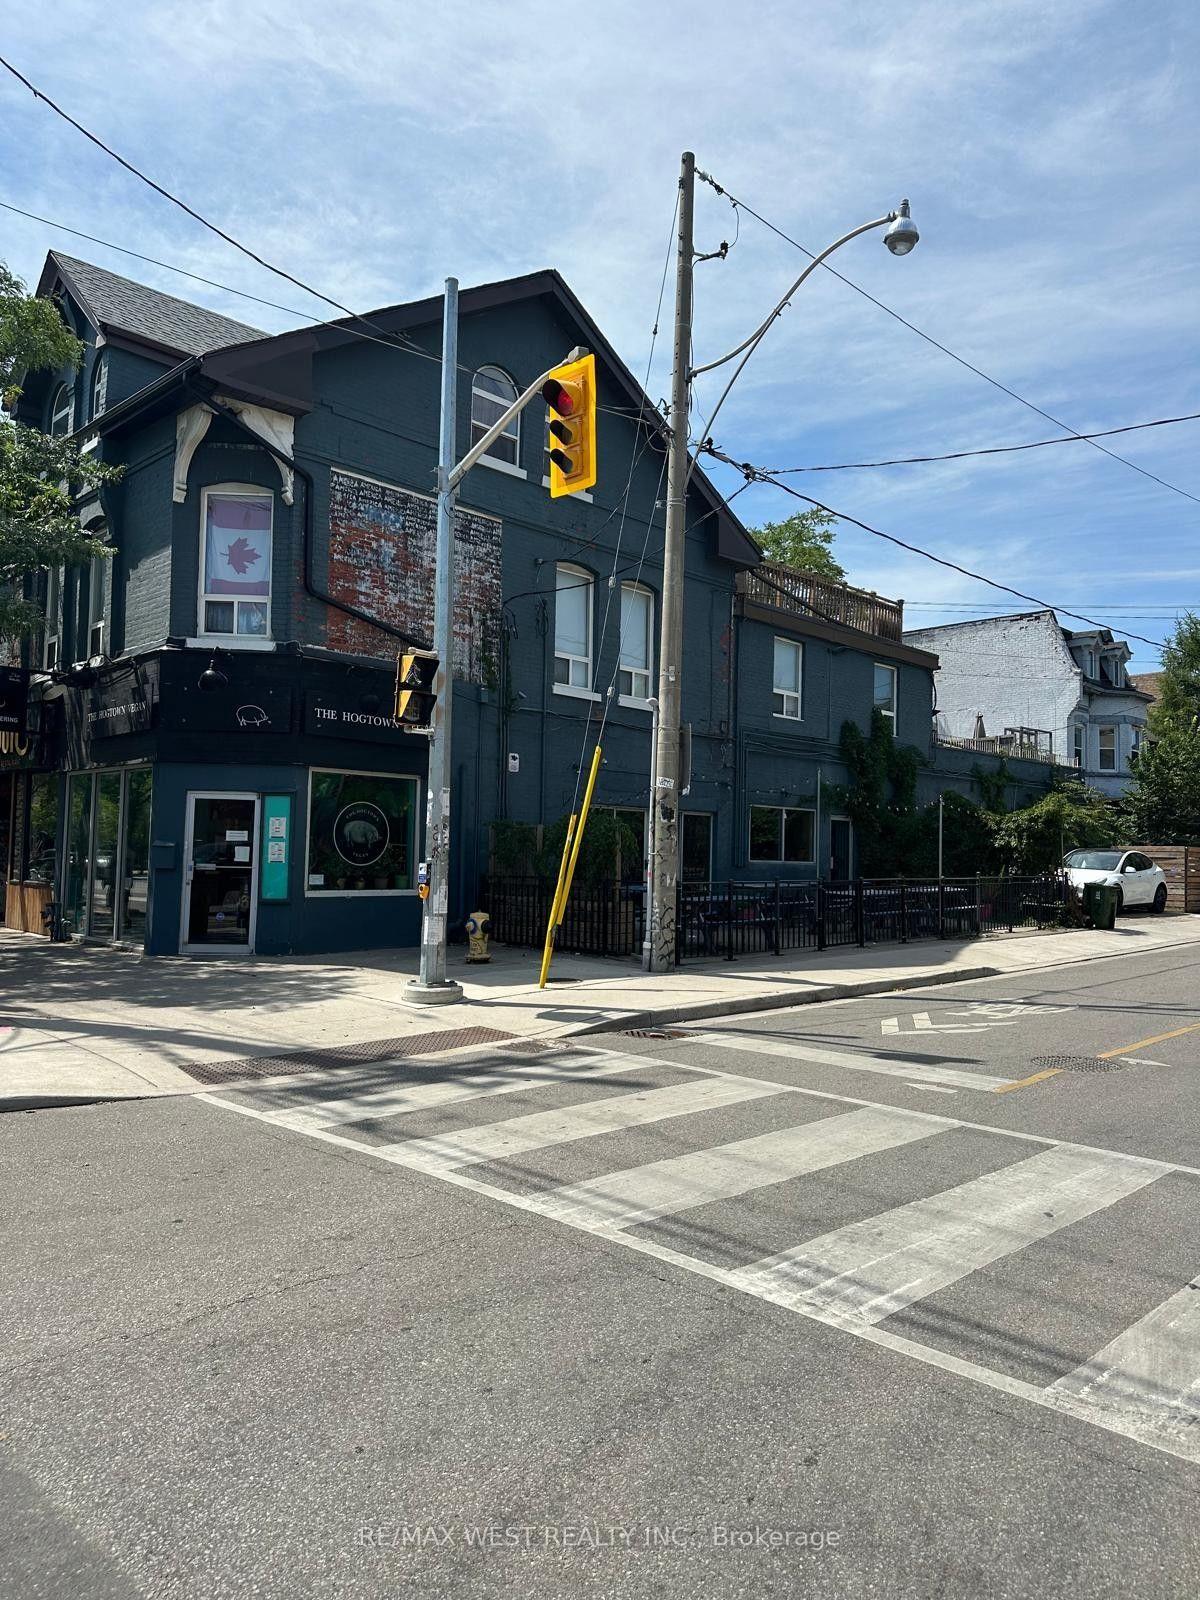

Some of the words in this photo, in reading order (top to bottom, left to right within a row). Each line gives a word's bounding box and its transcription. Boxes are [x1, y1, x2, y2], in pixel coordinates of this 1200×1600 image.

[98, 705, 126, 720] HOGTOWN
[128, 701, 146, 713] VEGAN
[314, 707, 338, 720] THE
[342, 711, 399, 729] HOGTOWN
